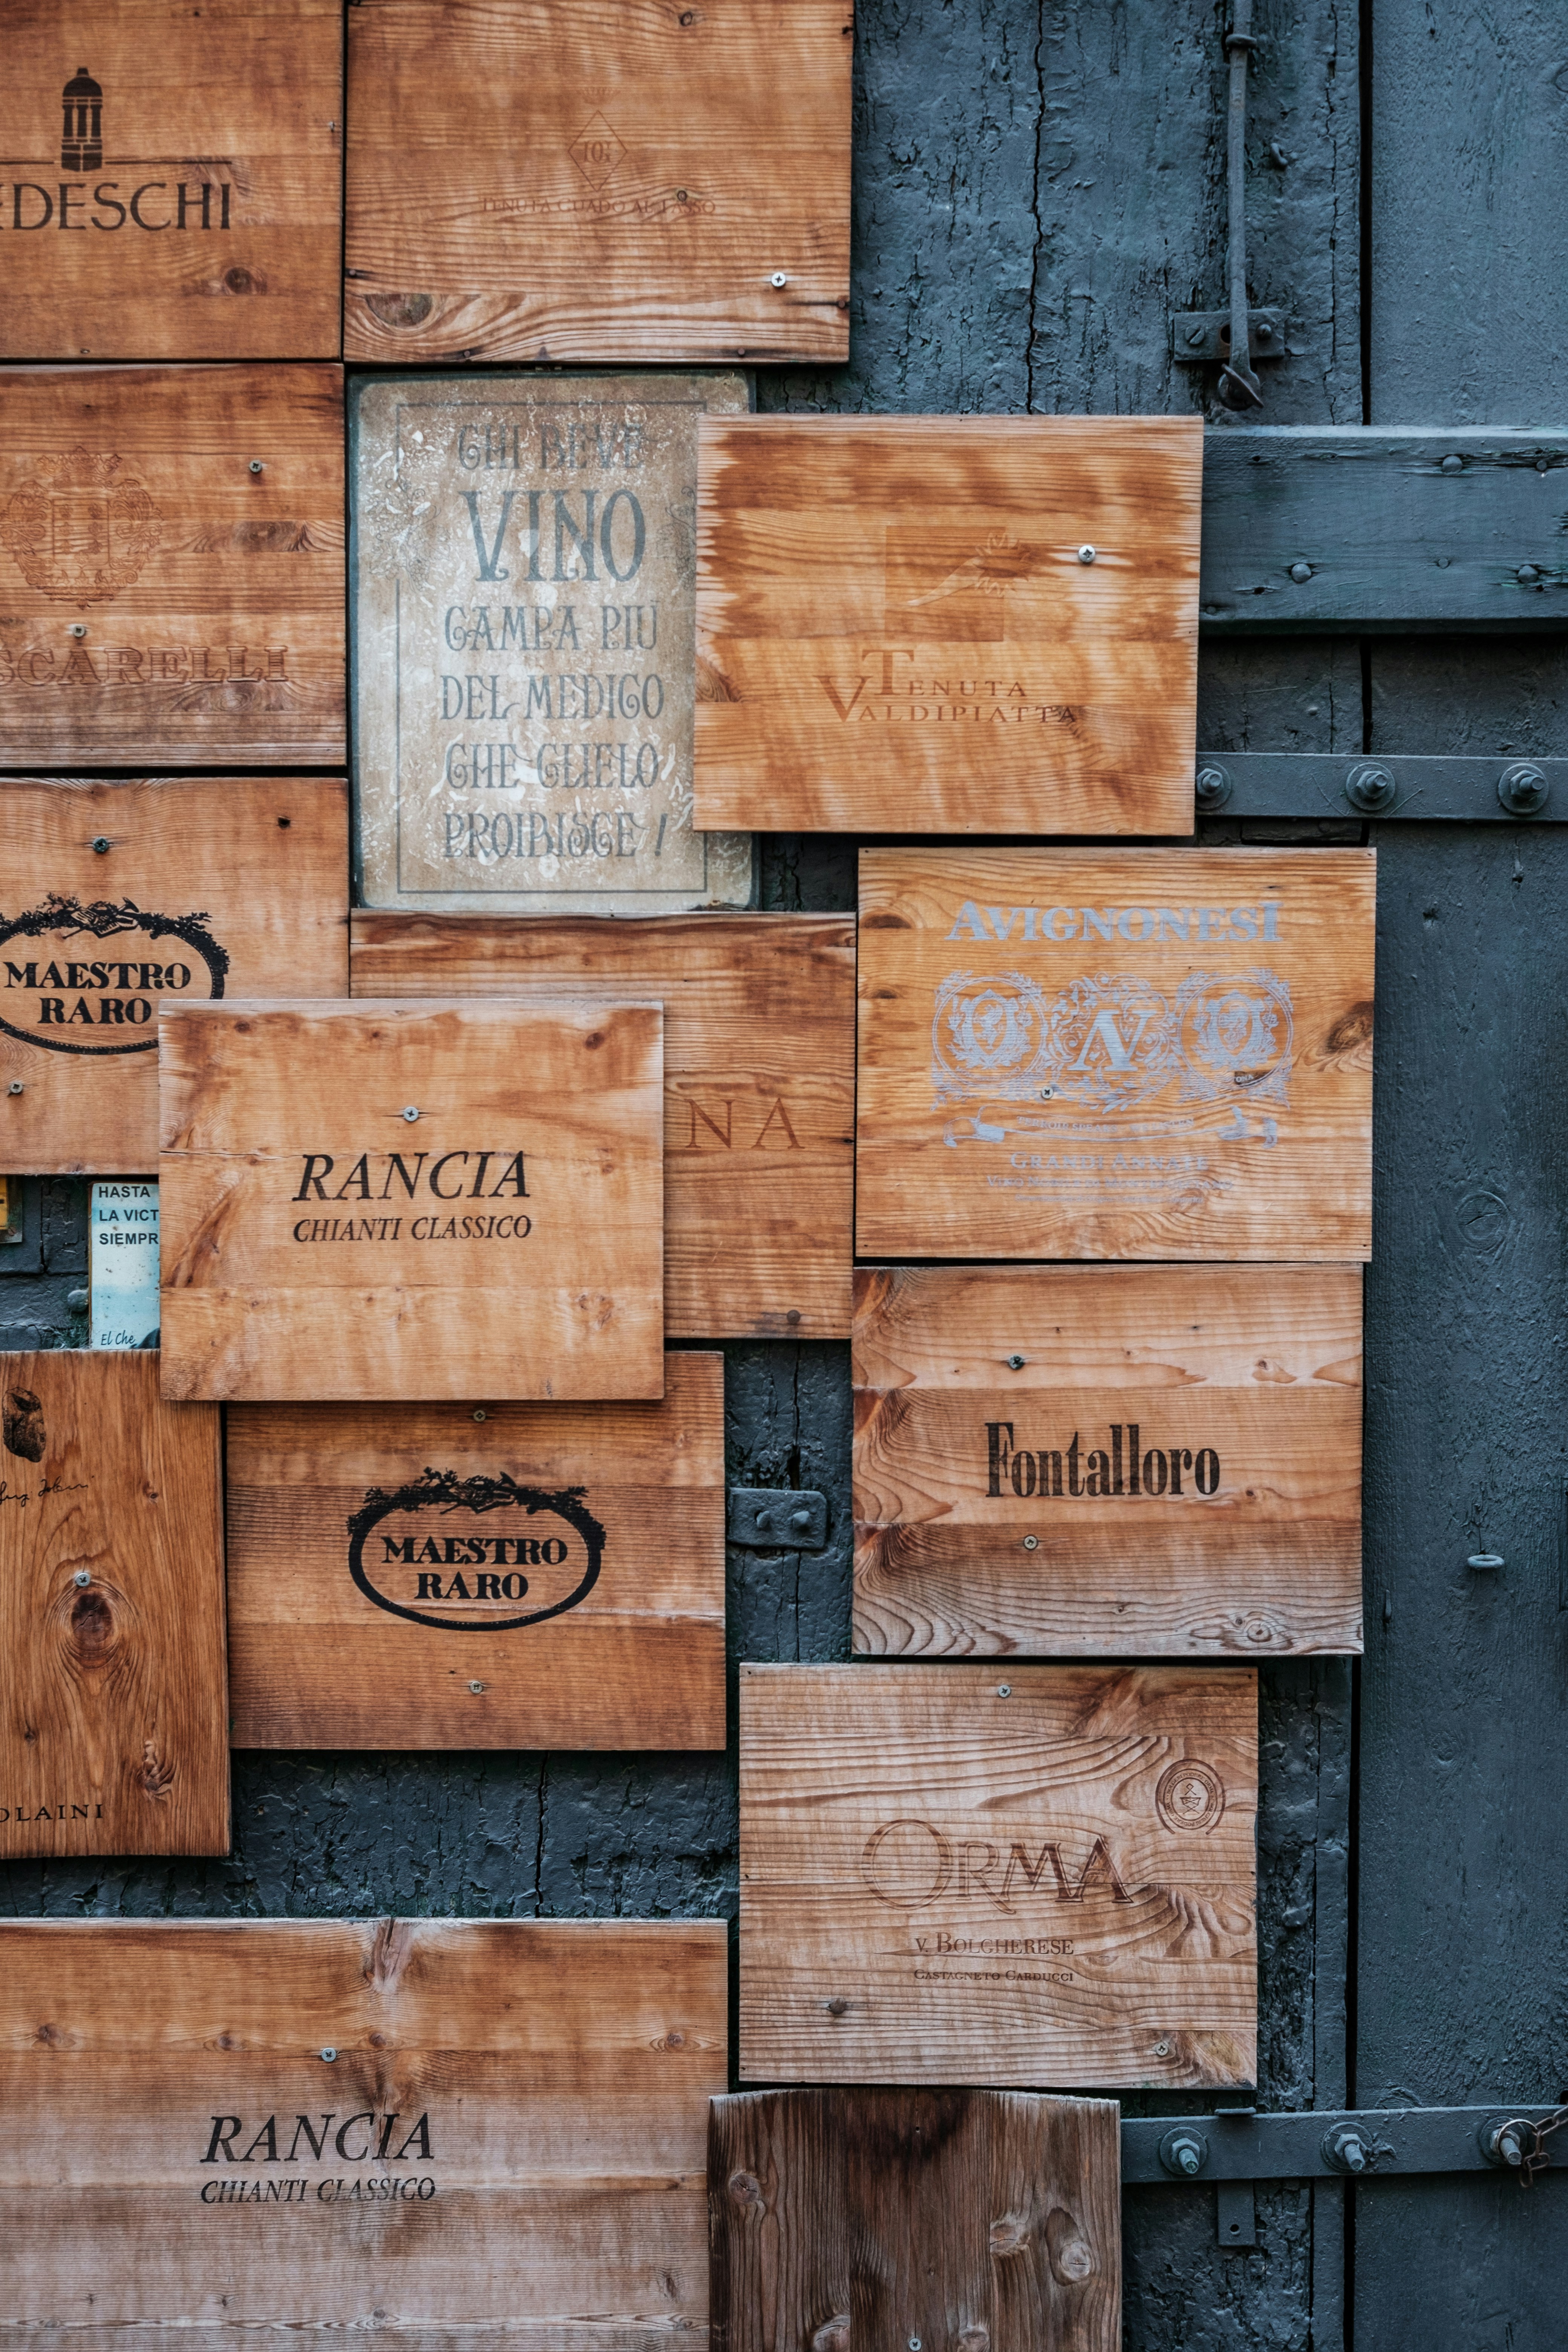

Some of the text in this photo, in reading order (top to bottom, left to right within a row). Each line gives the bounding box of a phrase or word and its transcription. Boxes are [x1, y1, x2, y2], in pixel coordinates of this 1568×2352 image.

[0, 182, 231, 231] DESCHI
[458, 488, 646, 582] VINO
[445, 605, 582, 651] CAMPA
[862, 649, 1027, 697] TENUTA
[439, 674, 665, 720] DEL MEDICO
[812, 675, 1078, 723] VALDIPIATTA
[446, 743, 659, 789] CHE GLIELO
[944, 900, 1283, 942] AVIGNONESI
[3, 960, 191, 989] MAESTRO
[37, 996, 152, 1024] RARO
[1010, 1152, 1208, 1170] GRANDI ANNATE
[292, 1150, 531, 1202] RANCIA
[99, 1186, 150, 1198] HASTA
[100, 1209, 159, 1221] LA VICT
[293, 1214, 532, 1243] CHIANTI CLASSICO
[99, 1233, 159, 1245] SIEMPR
[101, 1330, 136, 1346] El Che
[985, 1422, 1220, 1498] Fontalloro
[381, 1536, 568, 1565] MAESTRO
[414, 1571, 528, 1600] RARO
[861, 1818, 1134, 1915] ORMA
[935, 1932, 1074, 1955] BOLGHERESE
[914, 1969, 1073, 1981] CASTAGNETO CARDUCCI
[200, 2112, 435, 2163] RANCIA
[201, 2177, 436, 2203] CHIANTI CLASSICO
